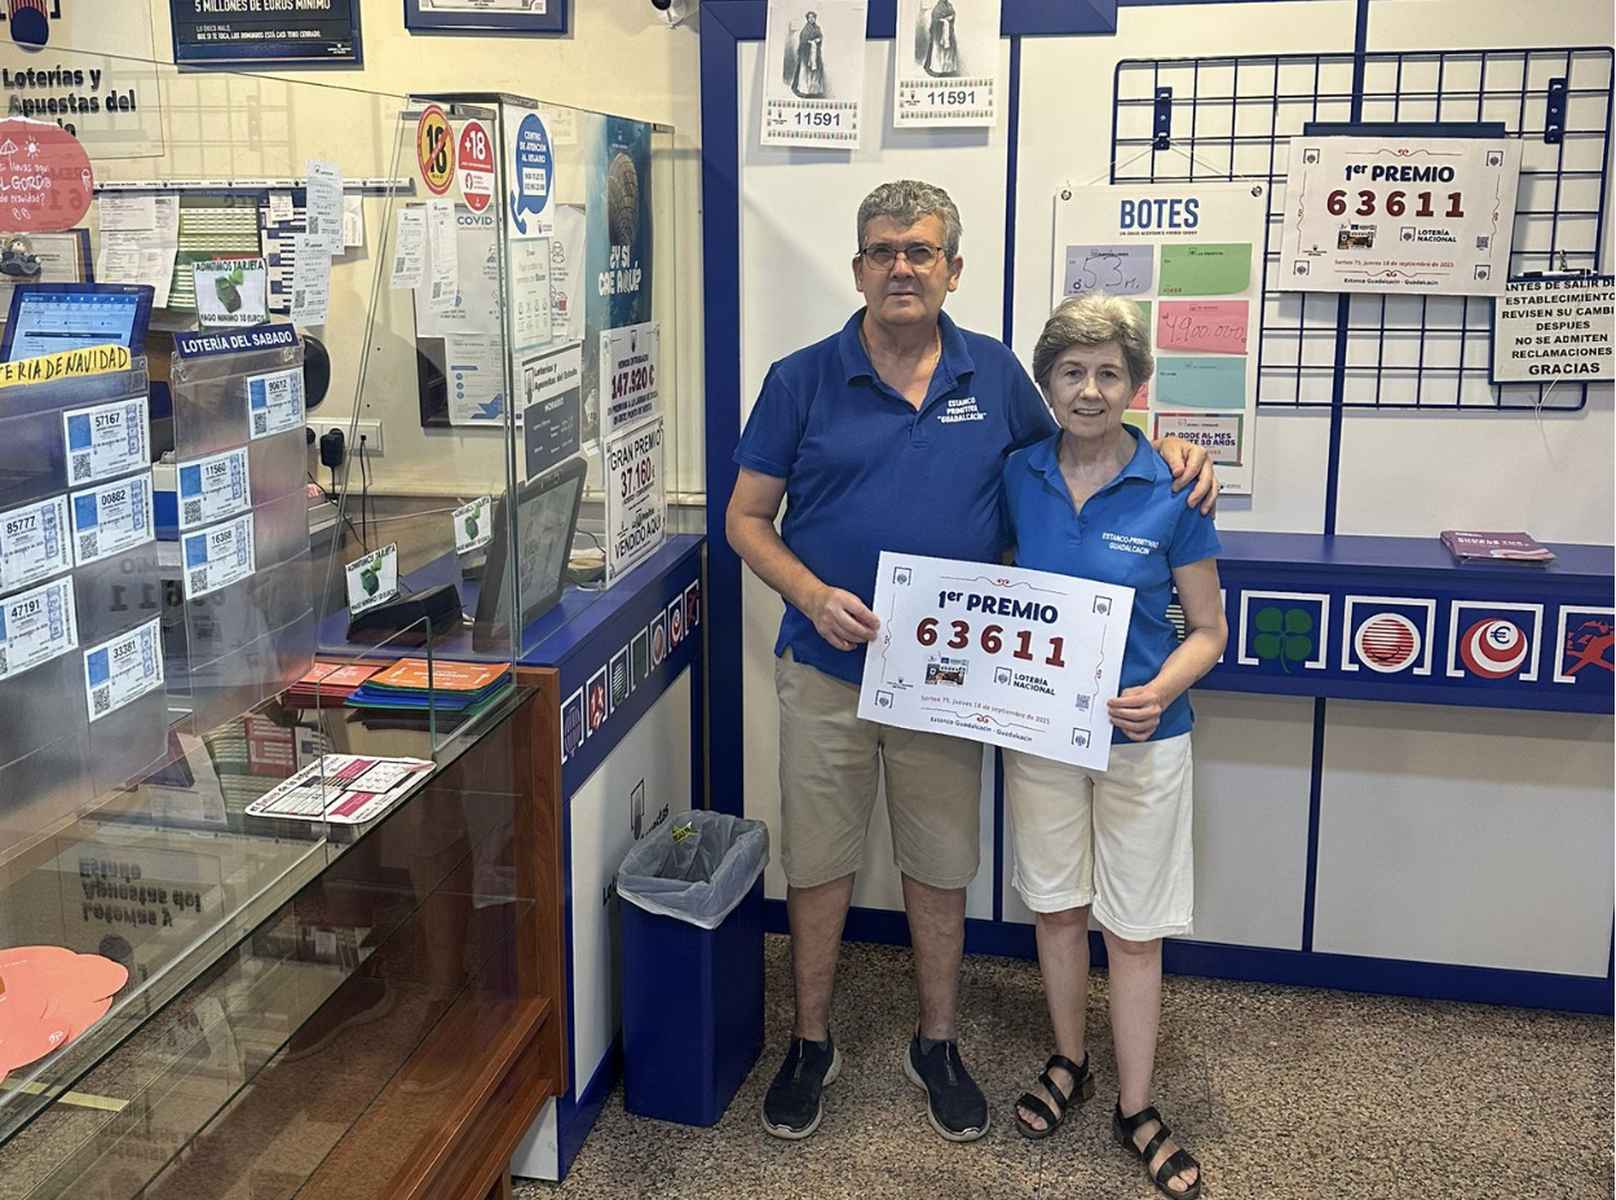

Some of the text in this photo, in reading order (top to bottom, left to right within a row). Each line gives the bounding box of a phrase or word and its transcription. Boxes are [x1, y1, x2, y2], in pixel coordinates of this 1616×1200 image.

[203, 0, 249, 12] MILLONES
[250, 0, 263, 11] DE
[3, 65, 101, 91] Loterías y
[8, 89, 136, 118] Apuestas del
[927, 90, 976, 105] 11591
[793, 112, 841, 127] 11591
[1345, 164, 1455, 183] 1er PREMIO
[1327, 189, 1465, 218] 63611
[1120, 198, 1200, 230] BOTES
[1417, 236, 1456, 244] NACIONAL
[598, 271, 616, 297] CAE
[1545, 281, 1561, 290] DE
[1564, 280, 1599, 290] SALIR
[1502, 308, 1553, 319] REVISEN
[1556, 308, 1572, 316] SU
[1536, 320, 1590, 331] DESPUES
[182, 334, 230, 354] LOTERÍA
[230, 335, 252, 349] DEL
[1516, 334, 1608, 345] NO SE ADMITEN
[1512, 347, 1612, 359] RECLAMACIONES
[0, 361, 41, 381] ERIA
[1528, 362, 1600, 375] GRACIAS
[95, 412, 120, 428] 57167
[610, 430, 660, 471] GRAN PREMIO
[6, 515, 36, 534] 85777
[11, 599, 40, 618] 47191
[938, 590, 1058, 624] 1er PREMIO
[916, 617, 1066, 668] 63611
[1014, 672, 1048, 687] LOTERÍA
[1013, 680, 1056, 696] NACIONAL
[952, 698, 973, 708] jueves
